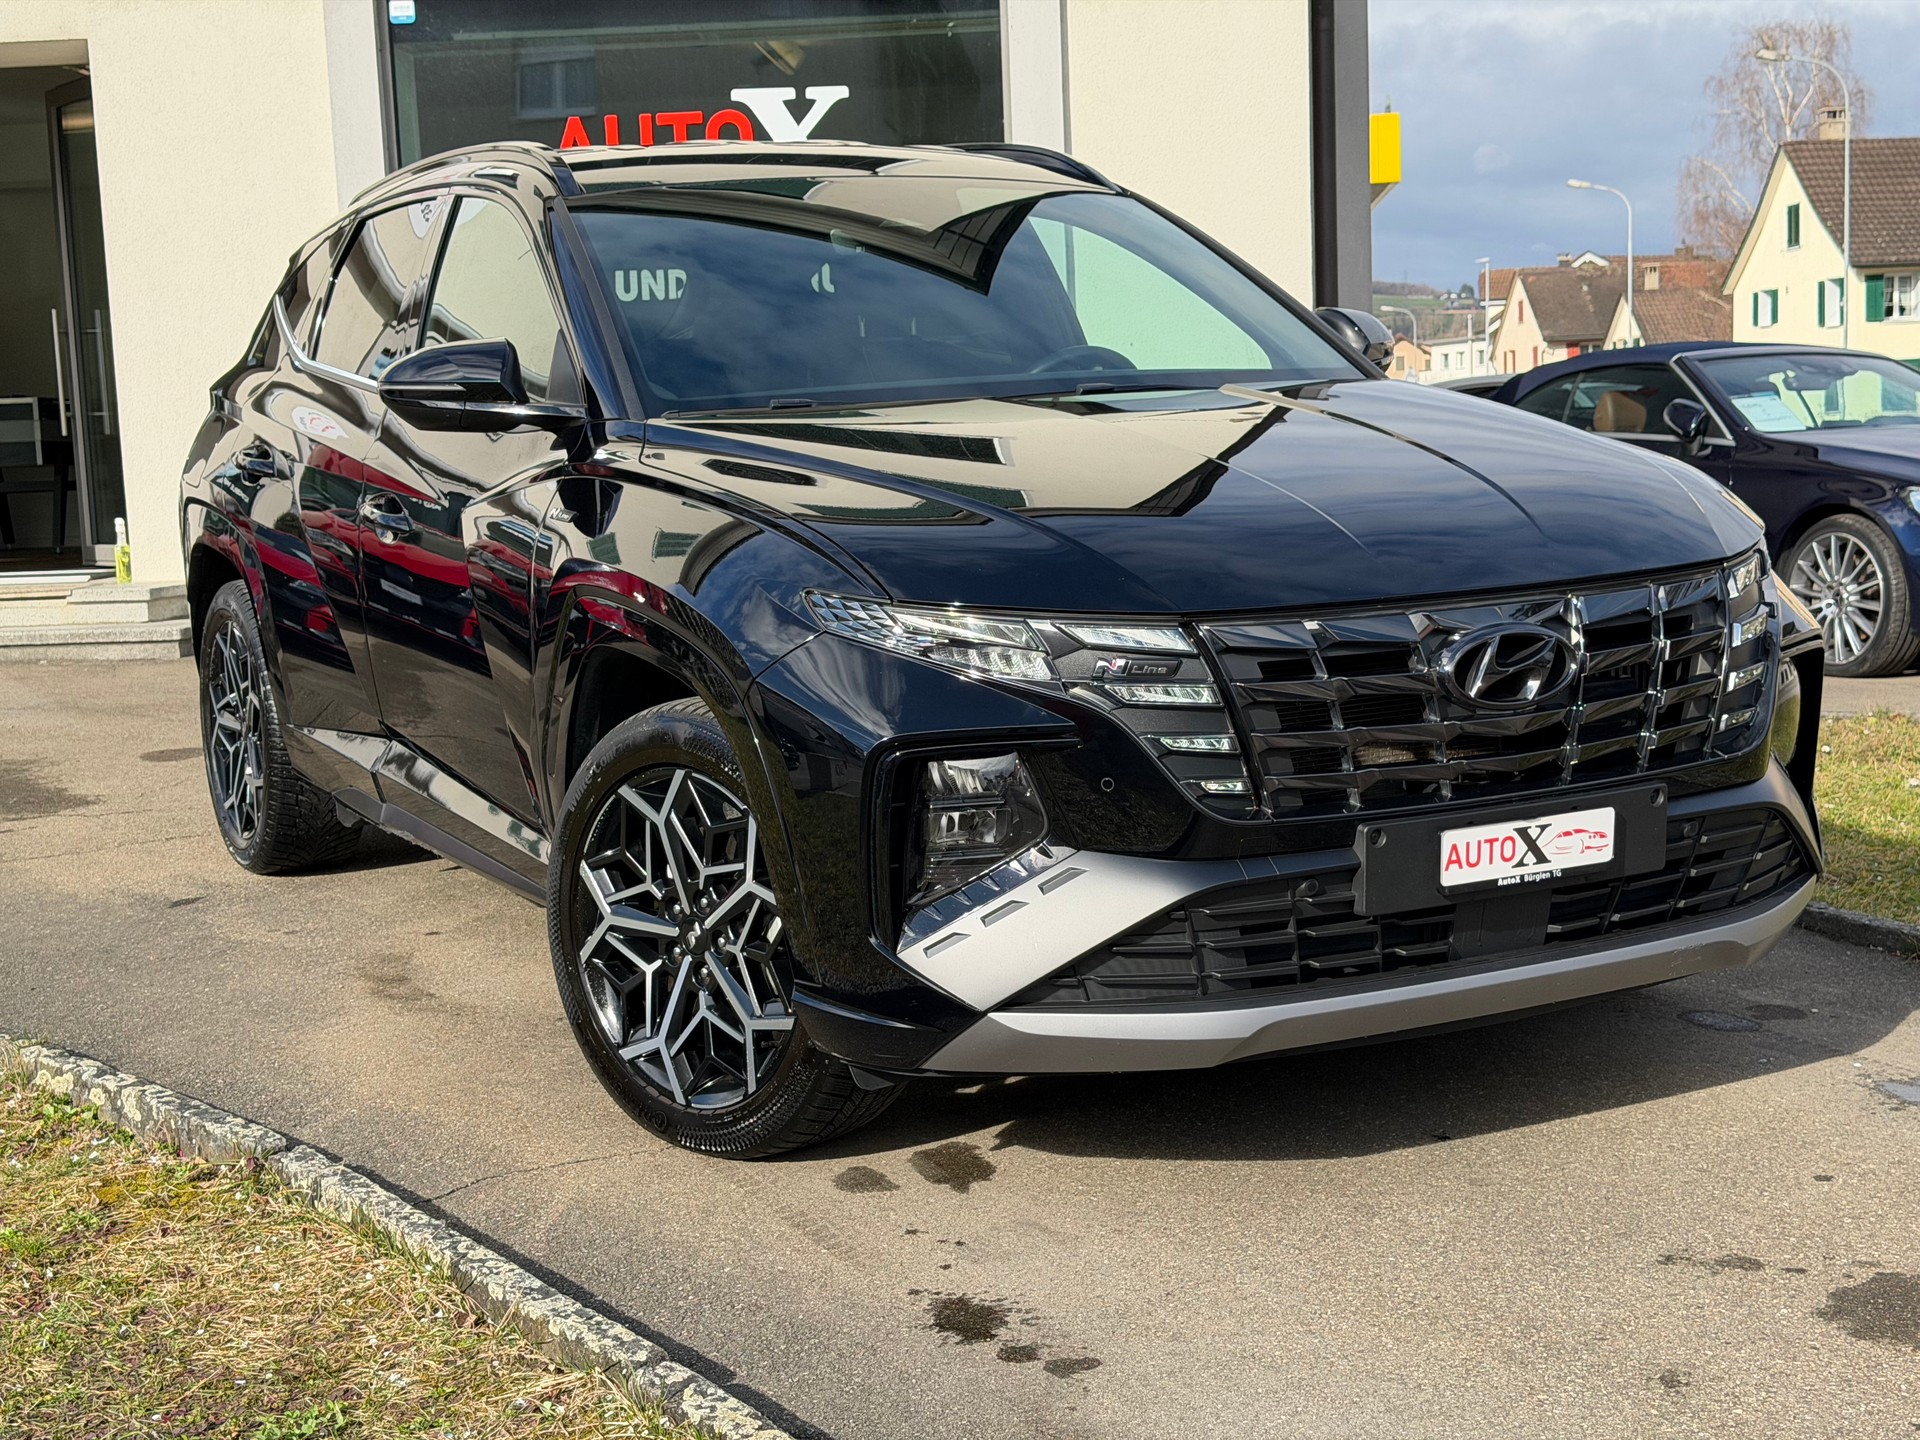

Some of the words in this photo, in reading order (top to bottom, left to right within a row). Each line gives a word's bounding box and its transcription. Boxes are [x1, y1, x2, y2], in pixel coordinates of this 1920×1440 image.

[1093, 659, 1128, 677] N
[1131, 665, 1168, 674] Line
[1497, 875, 1521, 887] AutoX
[1523, 872, 1551, 883] Bürglen
[1552, 869, 1562, 878] TG
